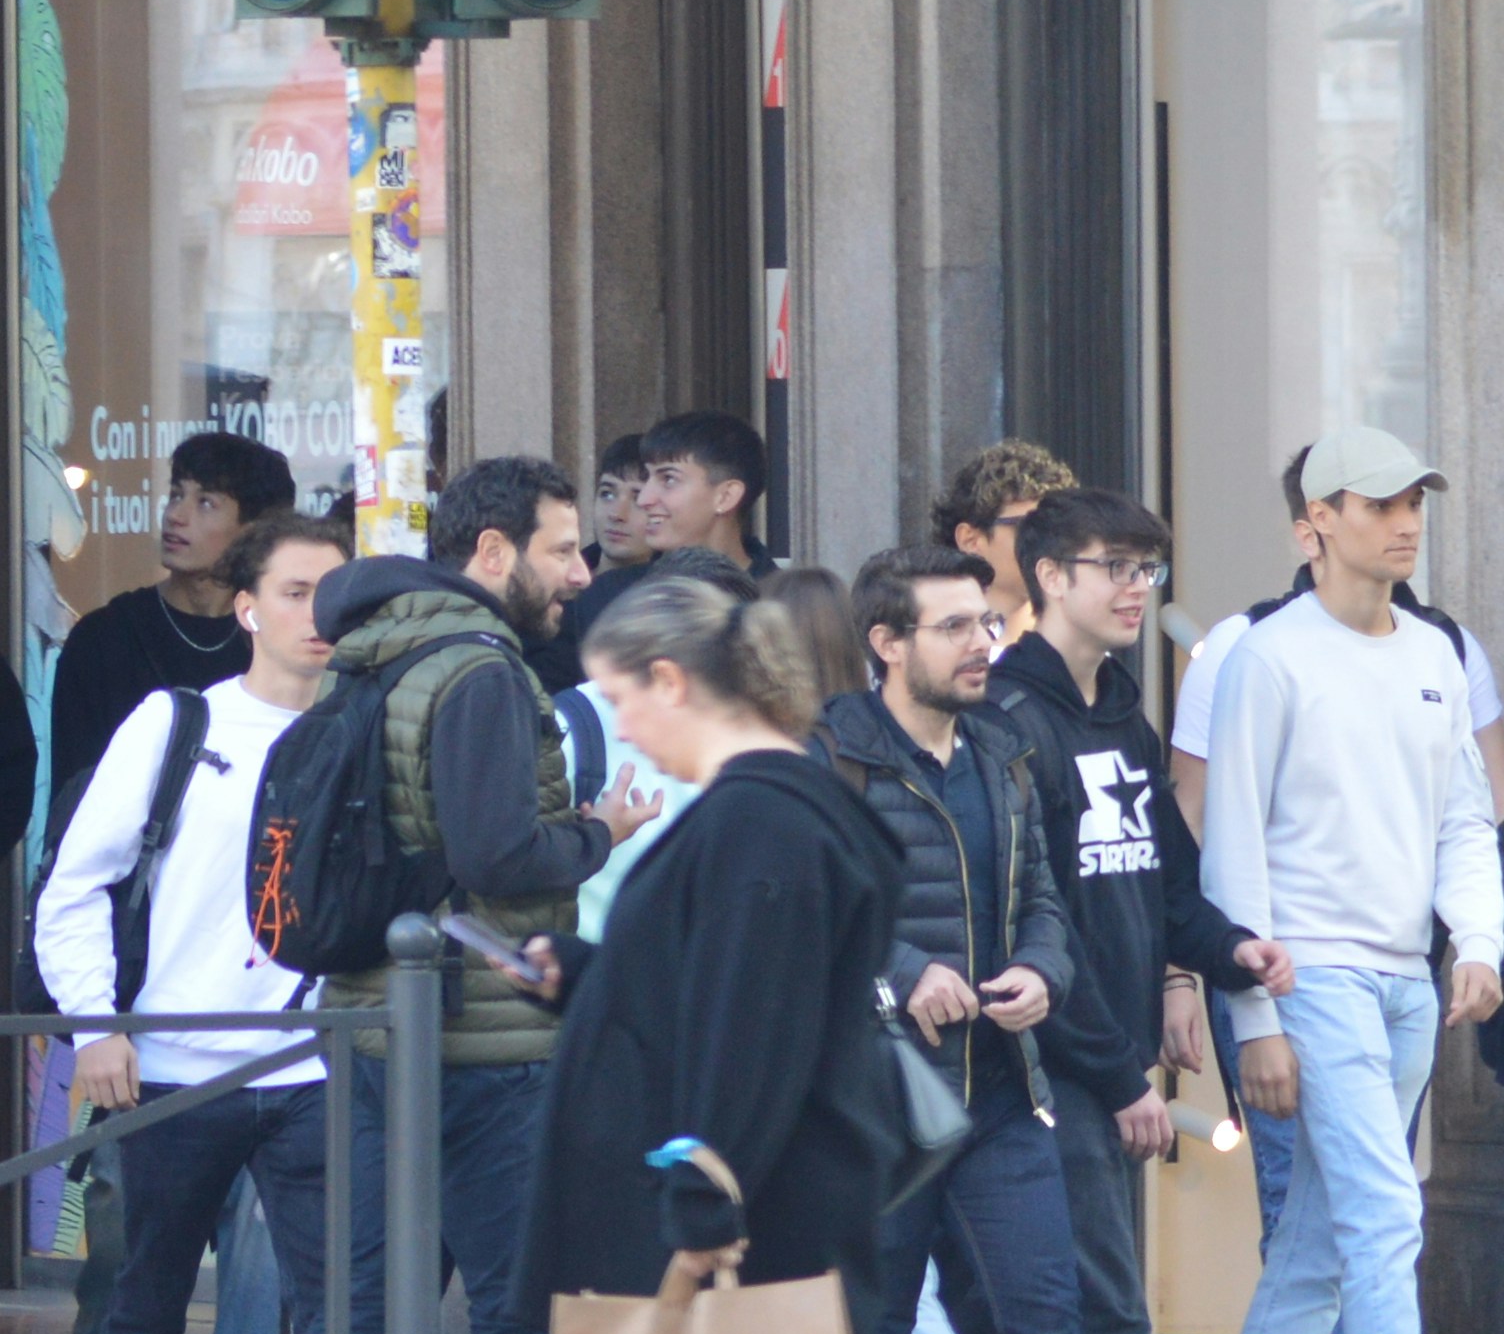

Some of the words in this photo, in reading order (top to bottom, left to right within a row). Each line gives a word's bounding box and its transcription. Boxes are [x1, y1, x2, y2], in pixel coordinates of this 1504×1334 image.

[90, 405, 137, 461] Con
[142, 405, 150, 458] i
[156, 407, 219, 457] nui
[225, 402, 297, 457] KOBO
[91, 481, 98, 534] i
[104, 480, 150, 535] tuoi
